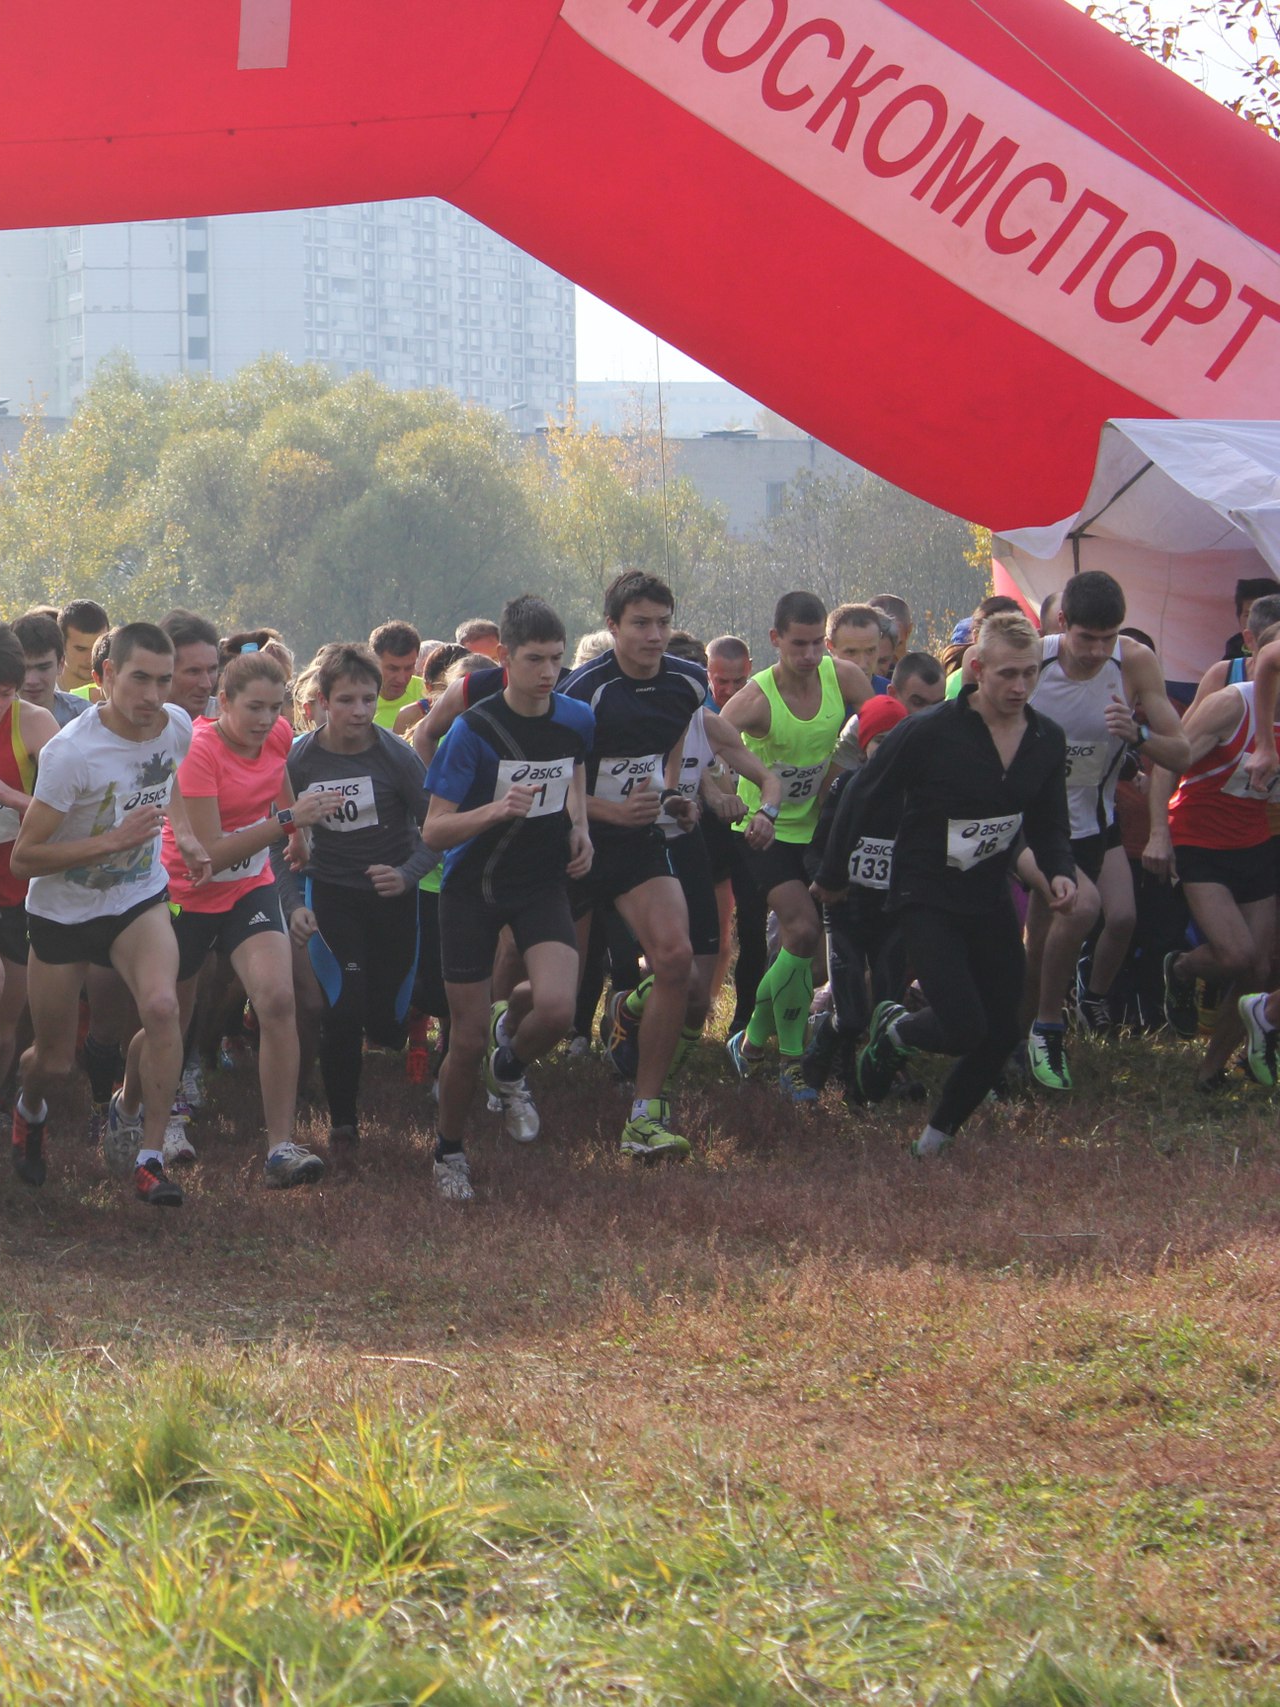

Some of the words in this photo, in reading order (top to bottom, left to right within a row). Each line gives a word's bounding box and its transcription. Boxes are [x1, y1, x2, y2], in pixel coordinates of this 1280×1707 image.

[529, 765, 563, 780] asics
[140, 786, 167, 806] asics
[788, 779, 813, 798] 25
[324, 799, 359, 824] 40
[980, 820, 1014, 837] asics
[851, 855, 890, 881] 133
